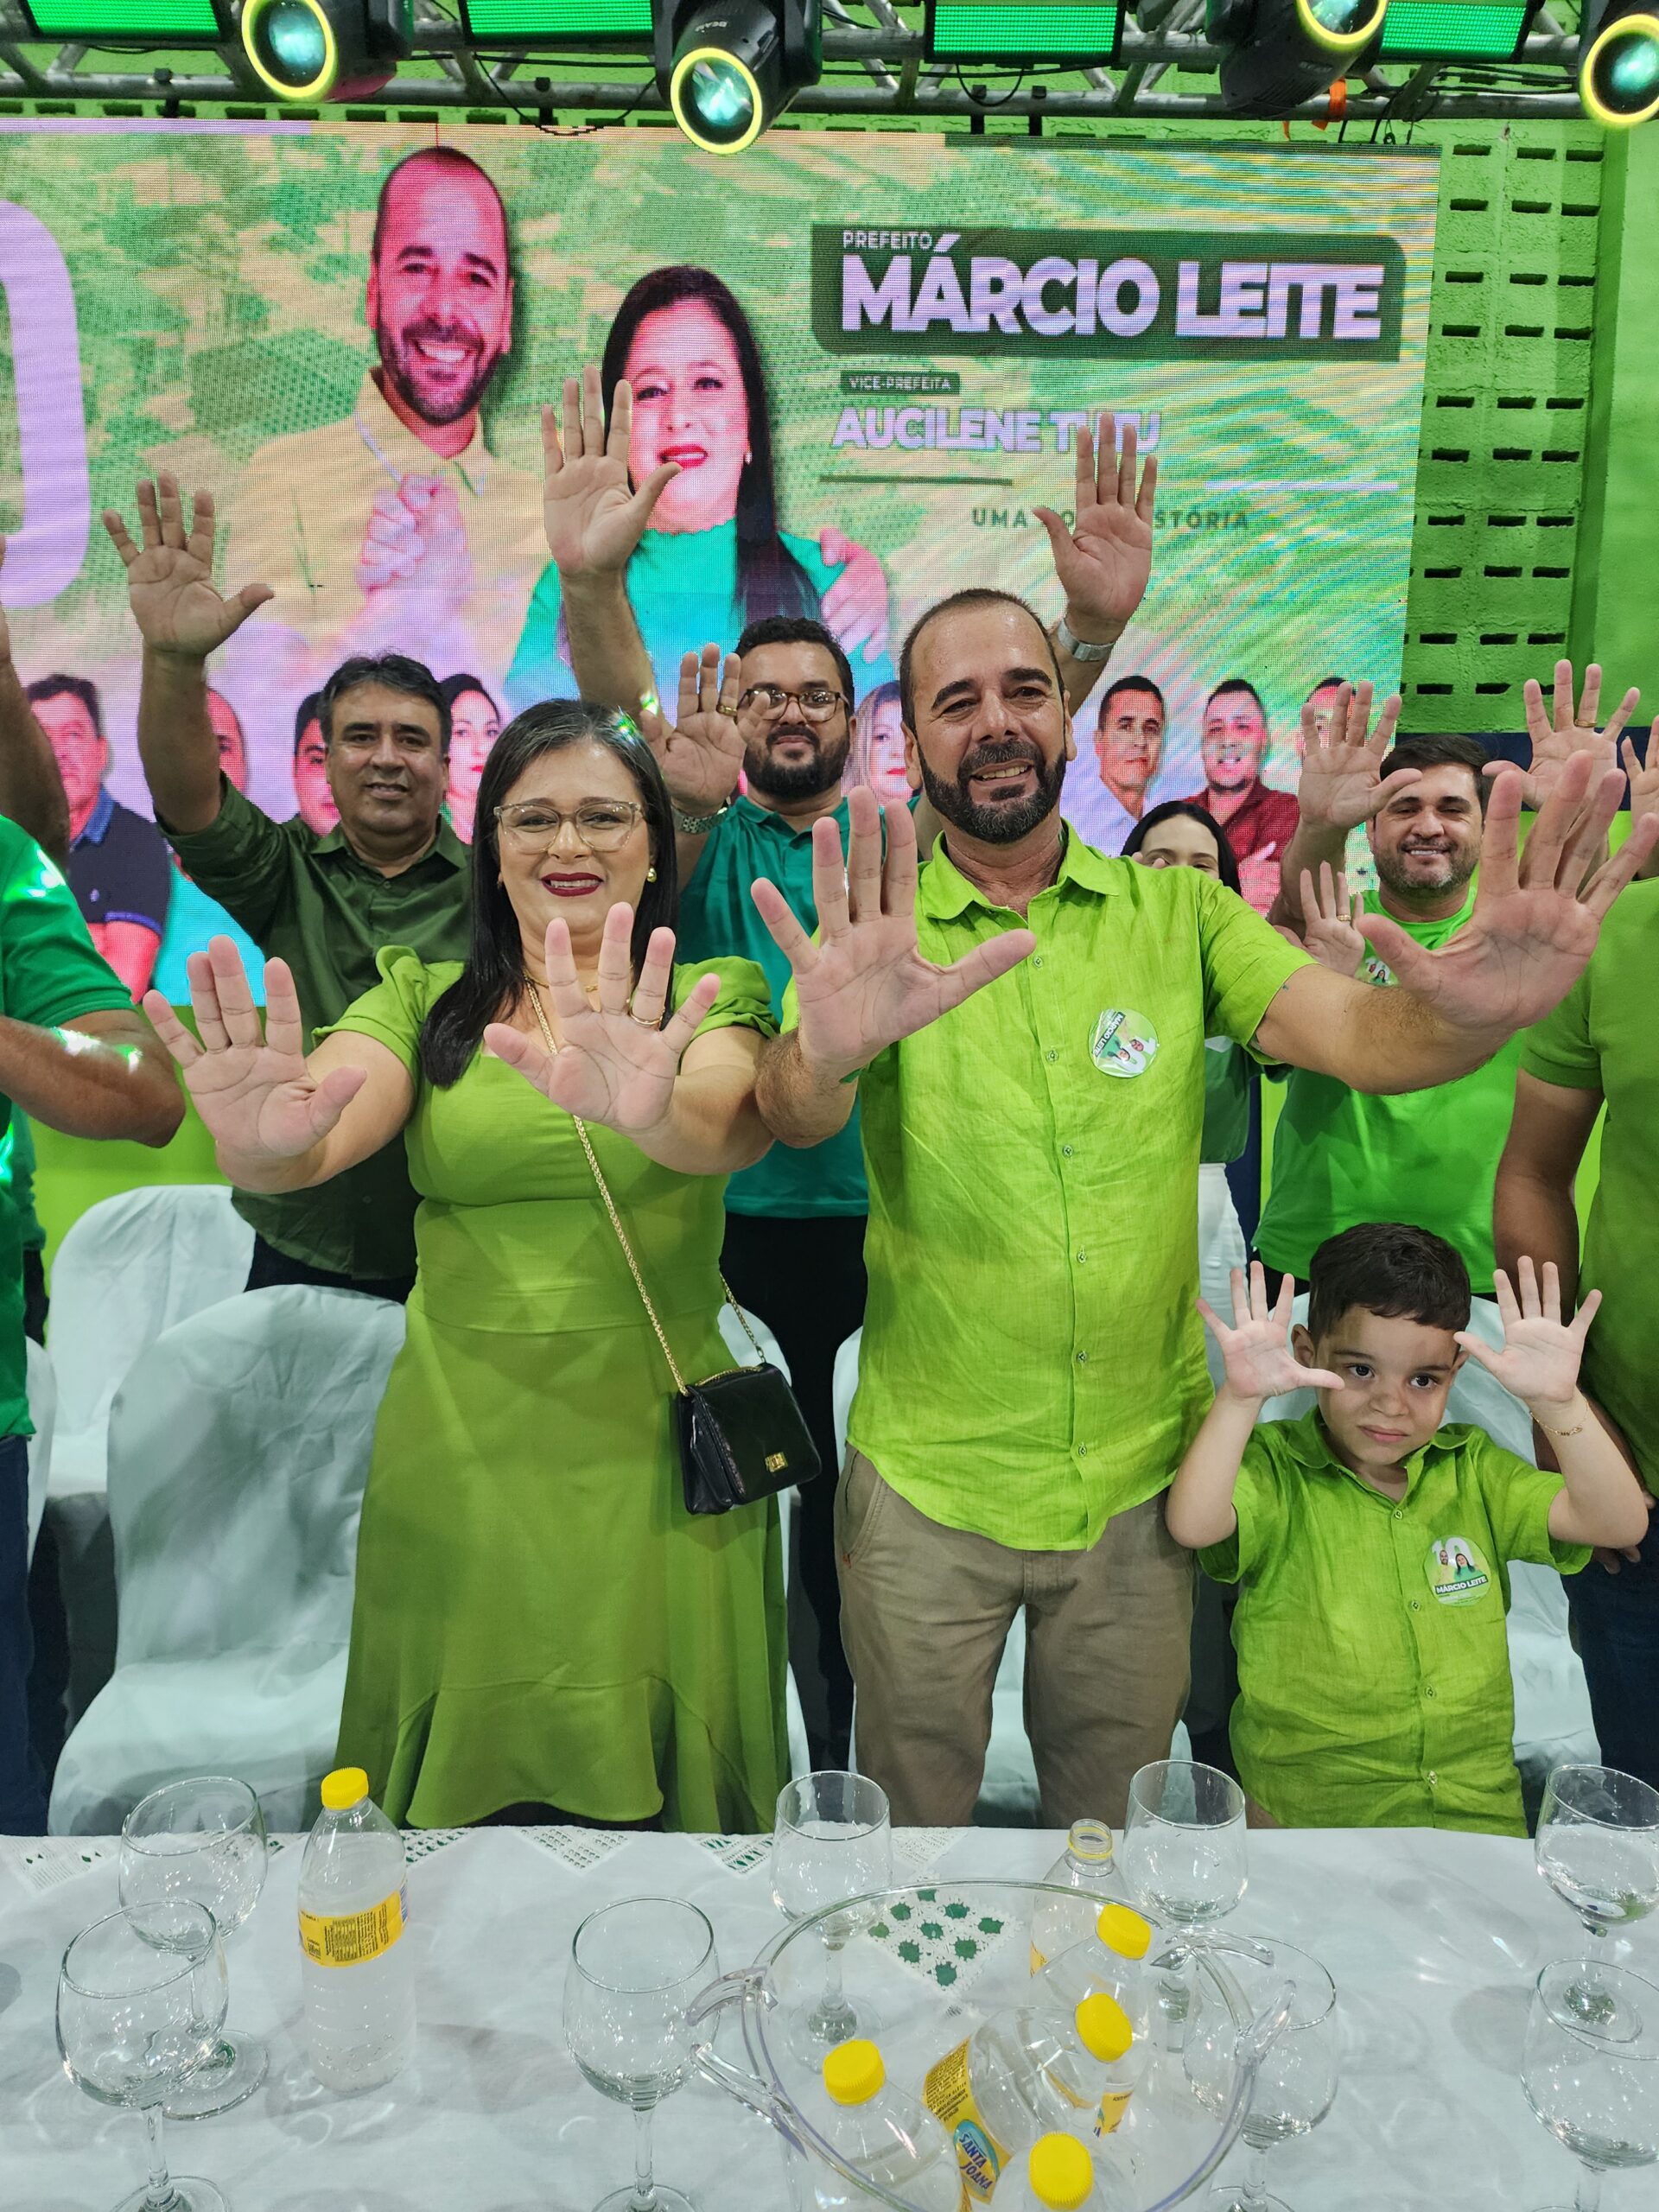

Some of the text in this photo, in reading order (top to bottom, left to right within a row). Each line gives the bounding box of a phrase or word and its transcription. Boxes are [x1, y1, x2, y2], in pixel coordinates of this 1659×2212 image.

[842, 231, 932, 250] PREFEITO
[842, 233, 1384, 340] MÁRCIO LEITE
[849, 375, 952, 391] VICE-PREFEITA
[830, 406, 1042, 453] AUCILENE
[972, 507, 1027, 528] UMA
[1154, 505, 1248, 529] STÓRIA
[1436, 1576, 1487, 1593] MÁRCIO LEITE
[959, 2133, 988, 2168] SANTA
[959, 2161, 994, 2190] JOANA
